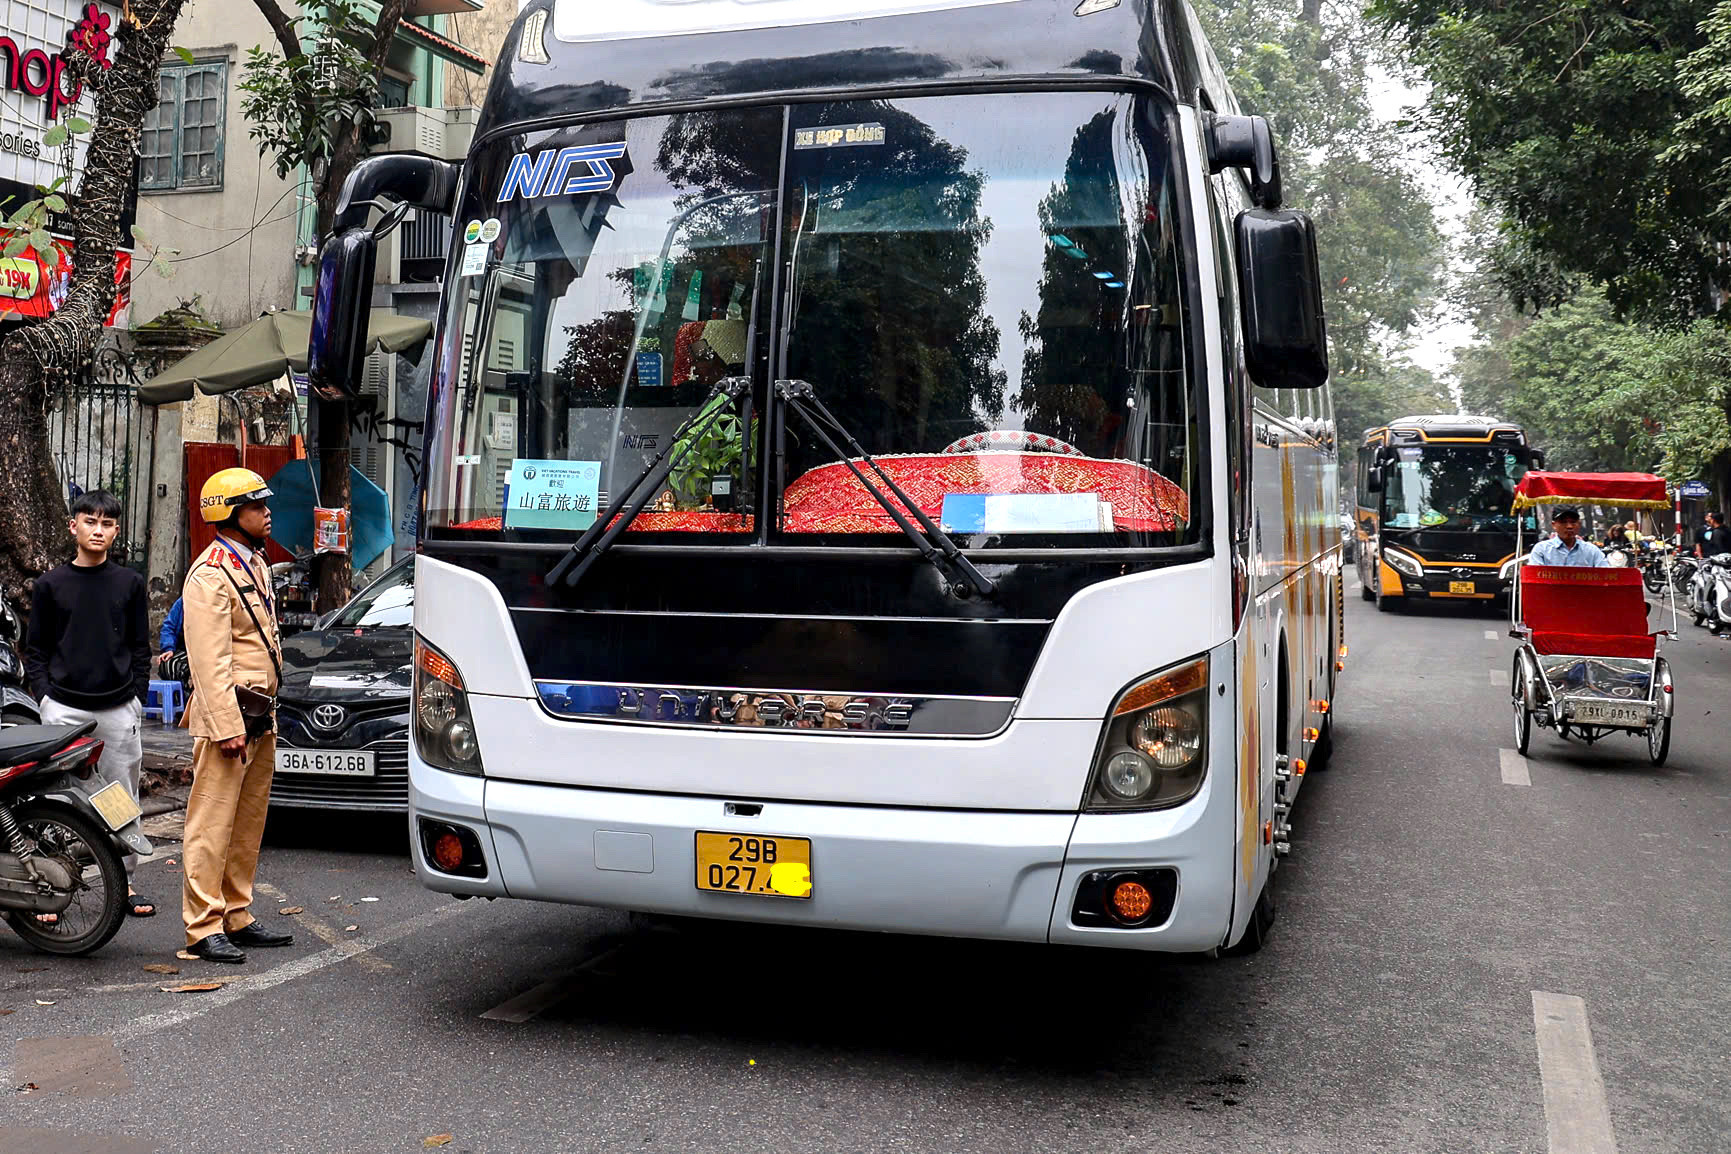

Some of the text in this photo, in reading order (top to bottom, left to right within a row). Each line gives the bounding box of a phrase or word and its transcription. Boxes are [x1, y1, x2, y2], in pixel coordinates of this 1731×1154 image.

[0, 131, 40, 157] ories
[796, 131, 814, 146] XE
[519, 492, 591, 513] 山富旅遊
[283, 753, 366, 771] 36A-612.68
[729, 837, 777, 864] 29B
[708, 864, 785, 893] 027.
